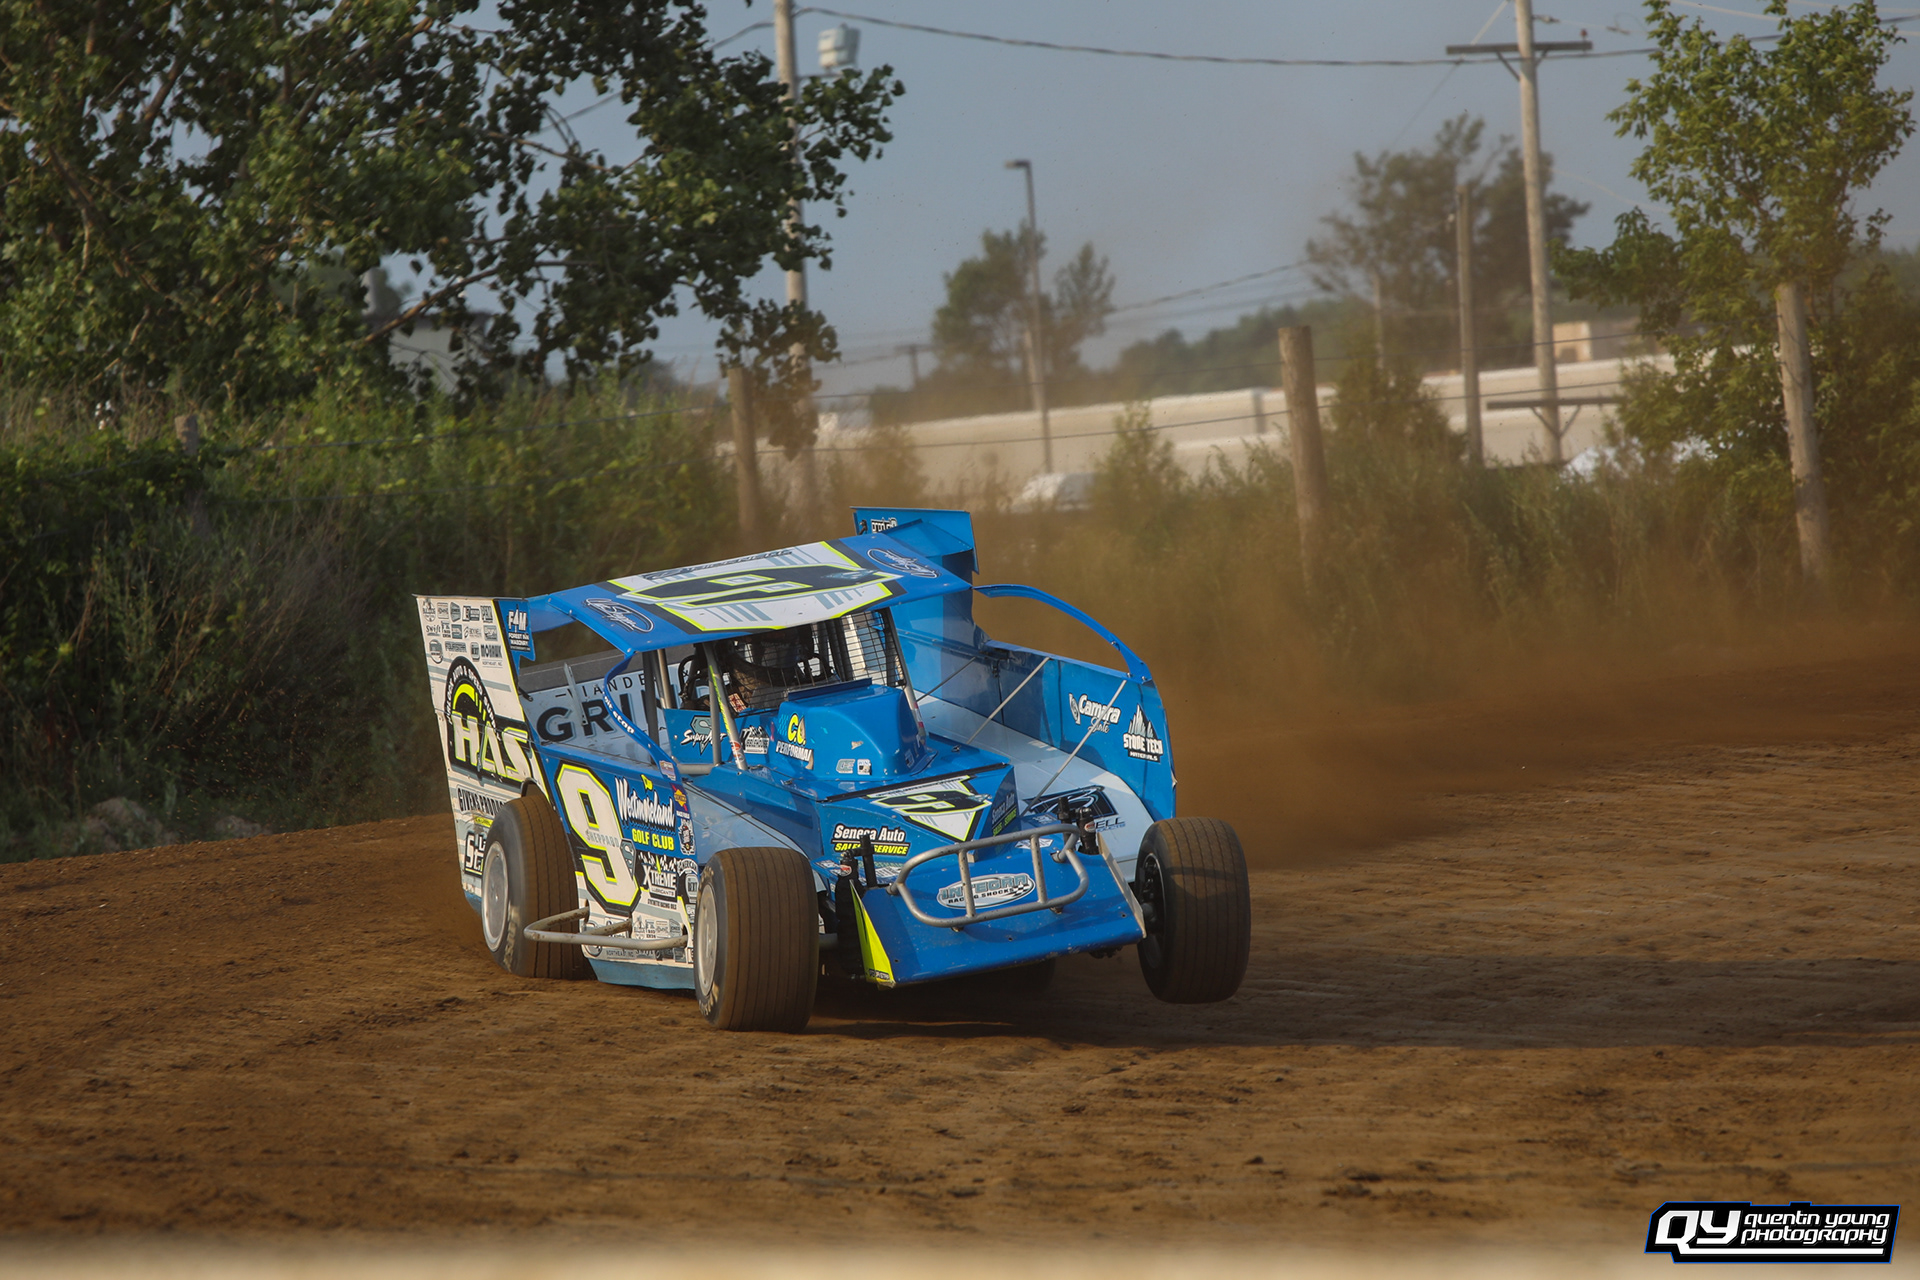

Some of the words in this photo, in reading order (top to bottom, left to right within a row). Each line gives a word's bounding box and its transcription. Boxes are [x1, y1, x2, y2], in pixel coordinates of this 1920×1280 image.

[1130, 751, 1158, 761] MATERIALS
[1147, 739, 1163, 755] TECH
[556, 762, 640, 908] 9
[632, 828, 650, 845] GOLF
[652, 834, 675, 850] CLUB
[878, 826, 906, 842] Auto
[643, 863, 677, 891] XTREME
[942, 875, 1028, 899] INEGRA
[948, 895, 979, 904] RACG
[981, 888, 1014, 898] SHOCKS
